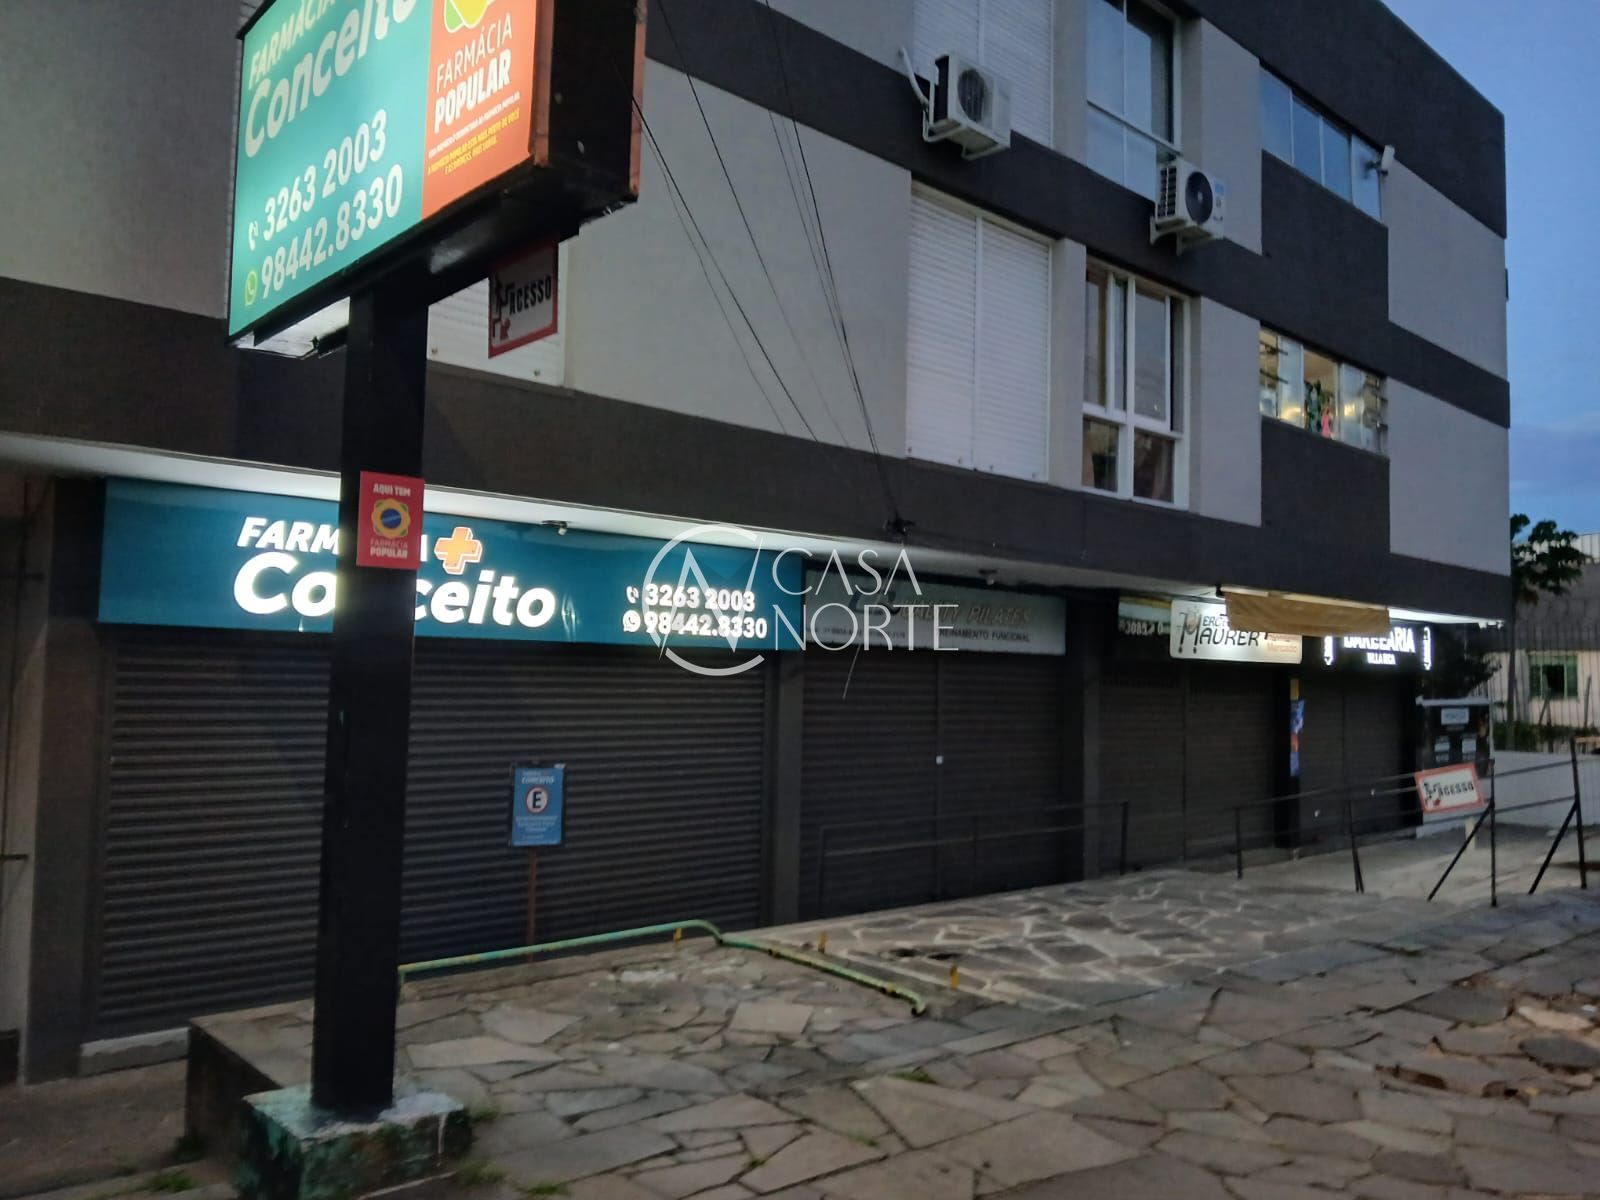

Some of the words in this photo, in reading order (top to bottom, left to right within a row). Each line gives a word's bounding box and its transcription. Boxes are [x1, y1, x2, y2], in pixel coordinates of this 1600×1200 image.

[436, 12, 513, 94] FARMÁCIA
[434, 48, 512, 135] POPULAR
[263, 164, 317, 241] 3263
[322, 108, 388, 199] 2003
[261, 163, 404, 299] 98442.8330
[509, 273, 552, 316] ACESSO
[373, 483, 393, 496] AQUI
[394, 486, 412, 497] TEM
[370, 547, 409, 560] POPULAR
[234, 552, 556, 628] Coeito
[644, 583, 700, 609] 3263
[704, 588, 756, 612] 2003
[643, 610, 768, 639] 98442.8330
[935, 628, 989, 641] REINAMENTO
[532, 791, 542, 809] E
